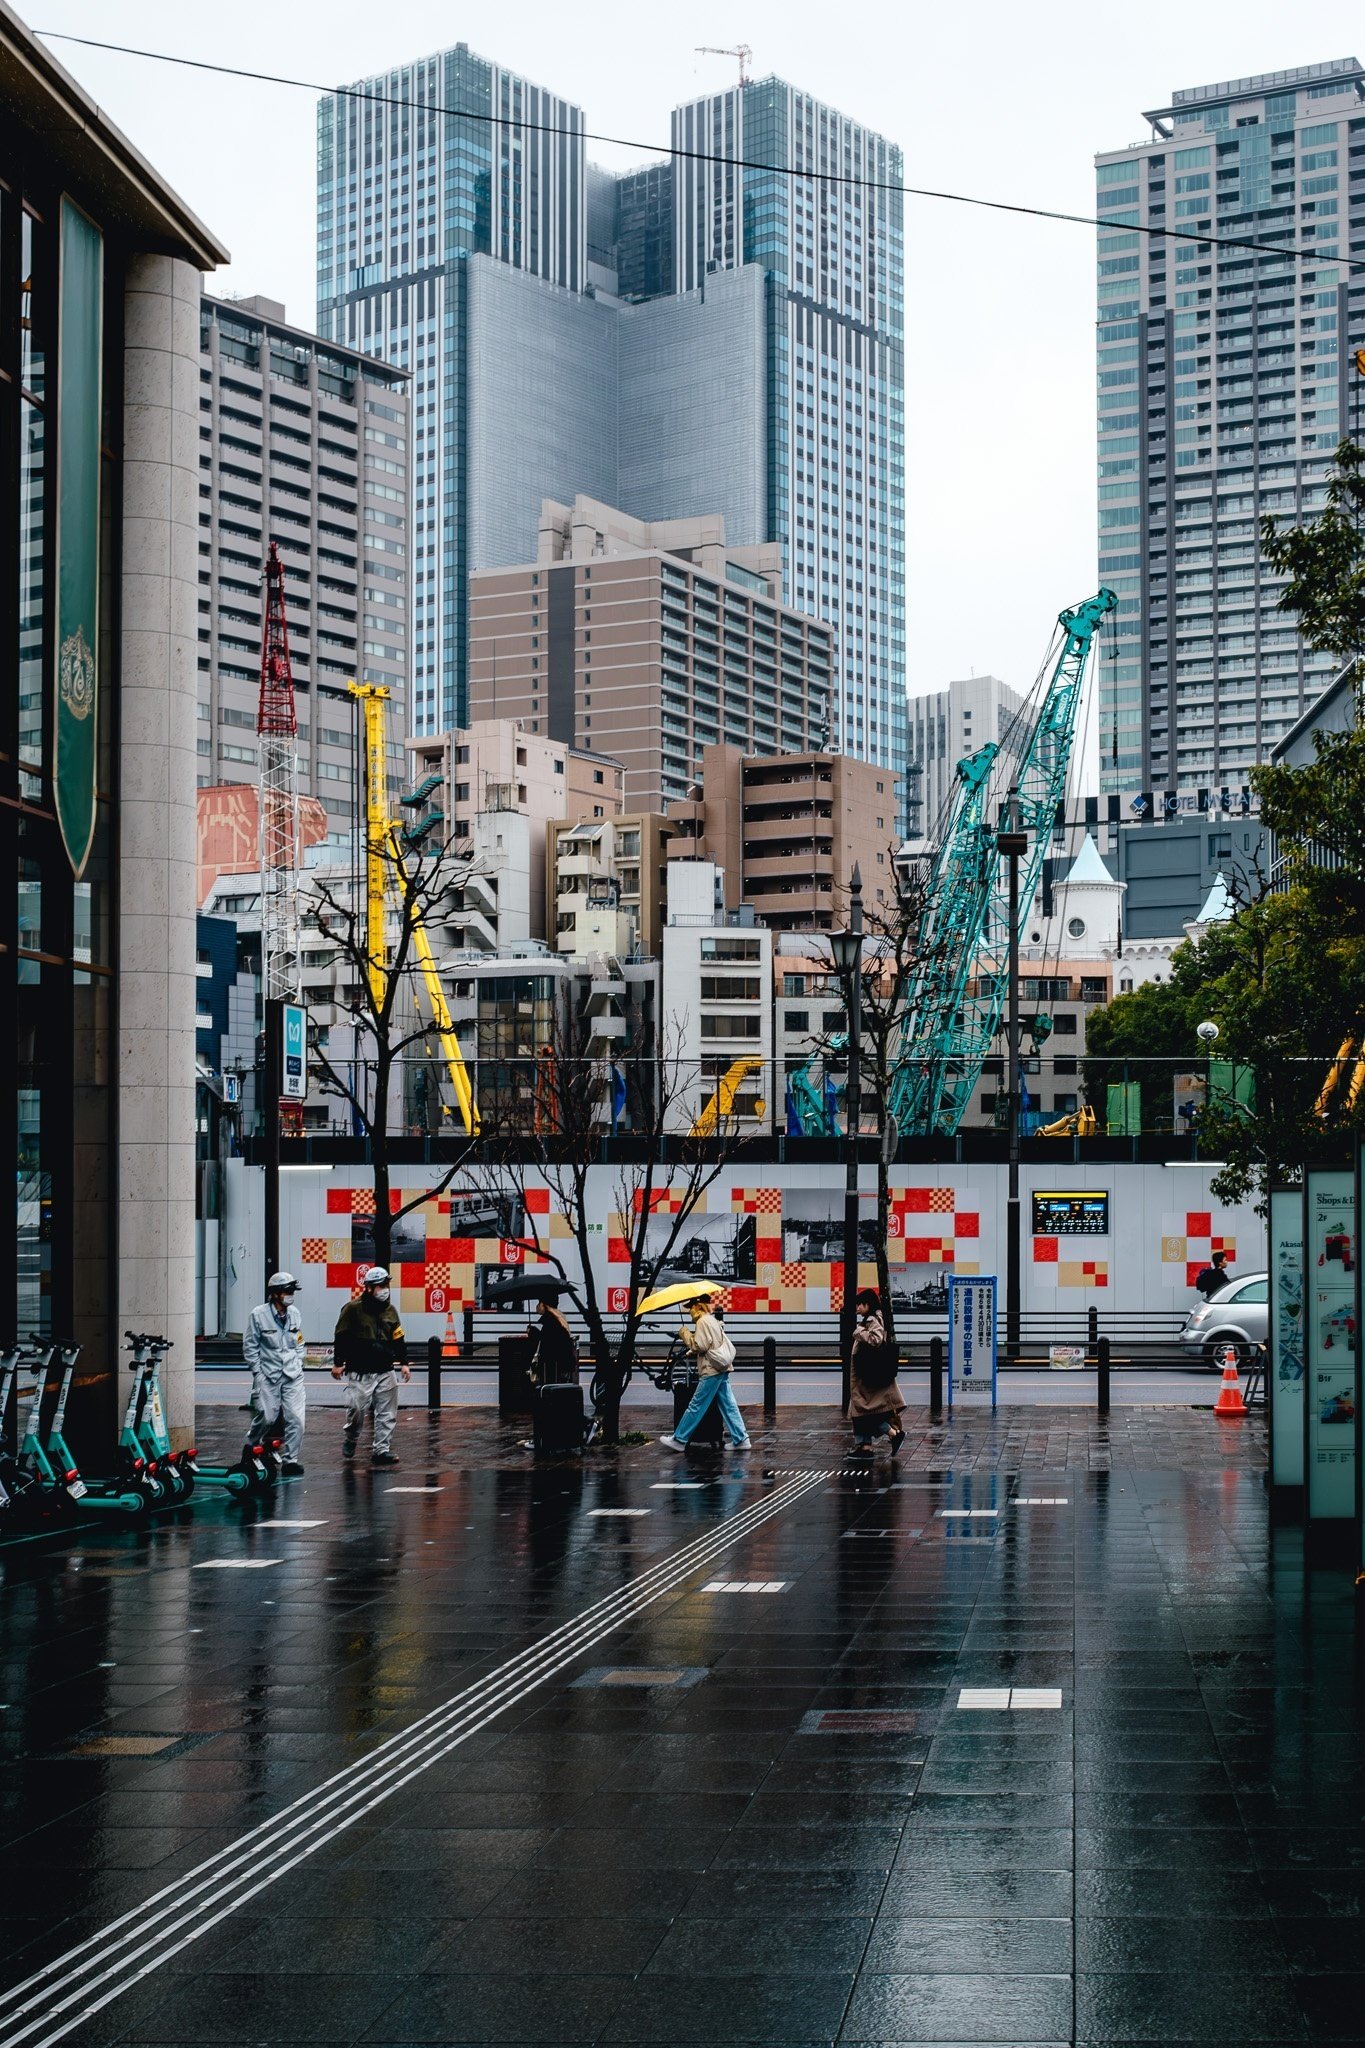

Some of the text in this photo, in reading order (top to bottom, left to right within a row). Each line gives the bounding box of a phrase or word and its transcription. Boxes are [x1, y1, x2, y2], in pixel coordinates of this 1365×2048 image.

[1160, 796, 1199, 812] HOTEL
[1317, 1196, 1341, 1206] Shops
[1318, 1213, 1328, 1221] 2F
[1318, 1294, 1328, 1302] 1F
[963, 1287, 973, 1376] 通信設備等の設置工事
[1318, 1374, 1332, 1383] B1F
